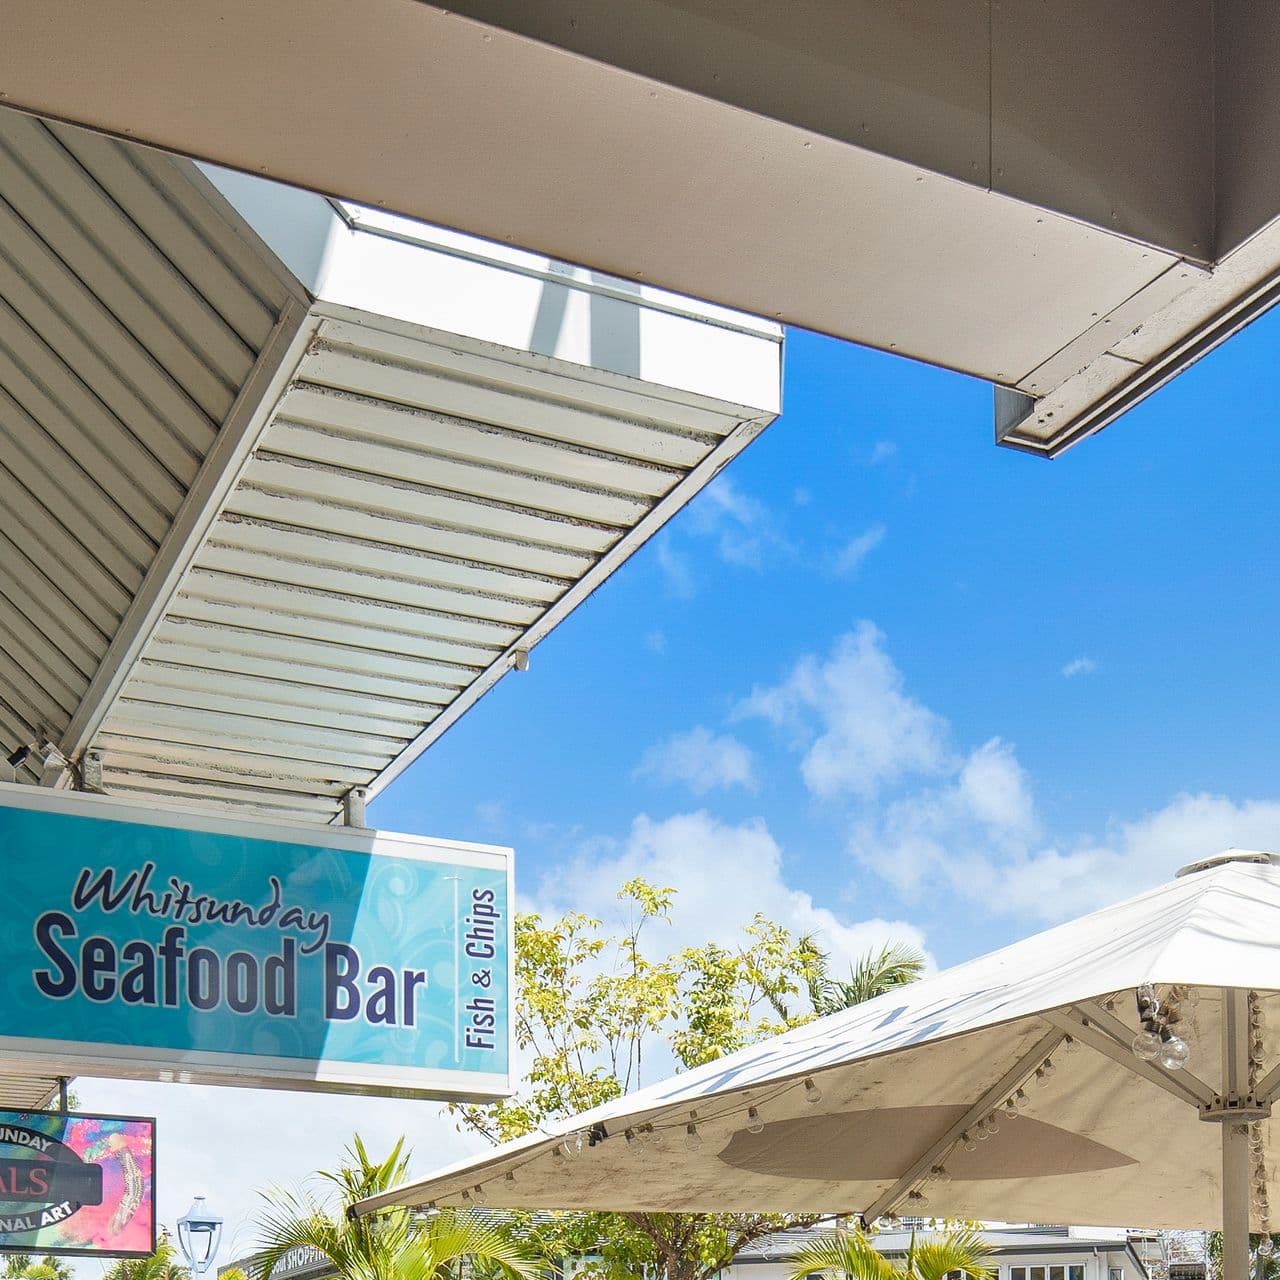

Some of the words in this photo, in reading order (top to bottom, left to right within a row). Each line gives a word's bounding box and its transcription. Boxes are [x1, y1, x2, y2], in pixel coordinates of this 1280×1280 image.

[71, 861, 331, 954] Whitsunday
[464, 887, 496, 960] Chips
[32, 910, 300, 1019] Seafood
[323, 940, 427, 1030] Bar
[470, 968, 493, 989] &
[464, 1002, 496, 1052] Fish
[40, 1200, 74, 1227] ART
[288, 1245, 328, 1270] SHOPPIN
